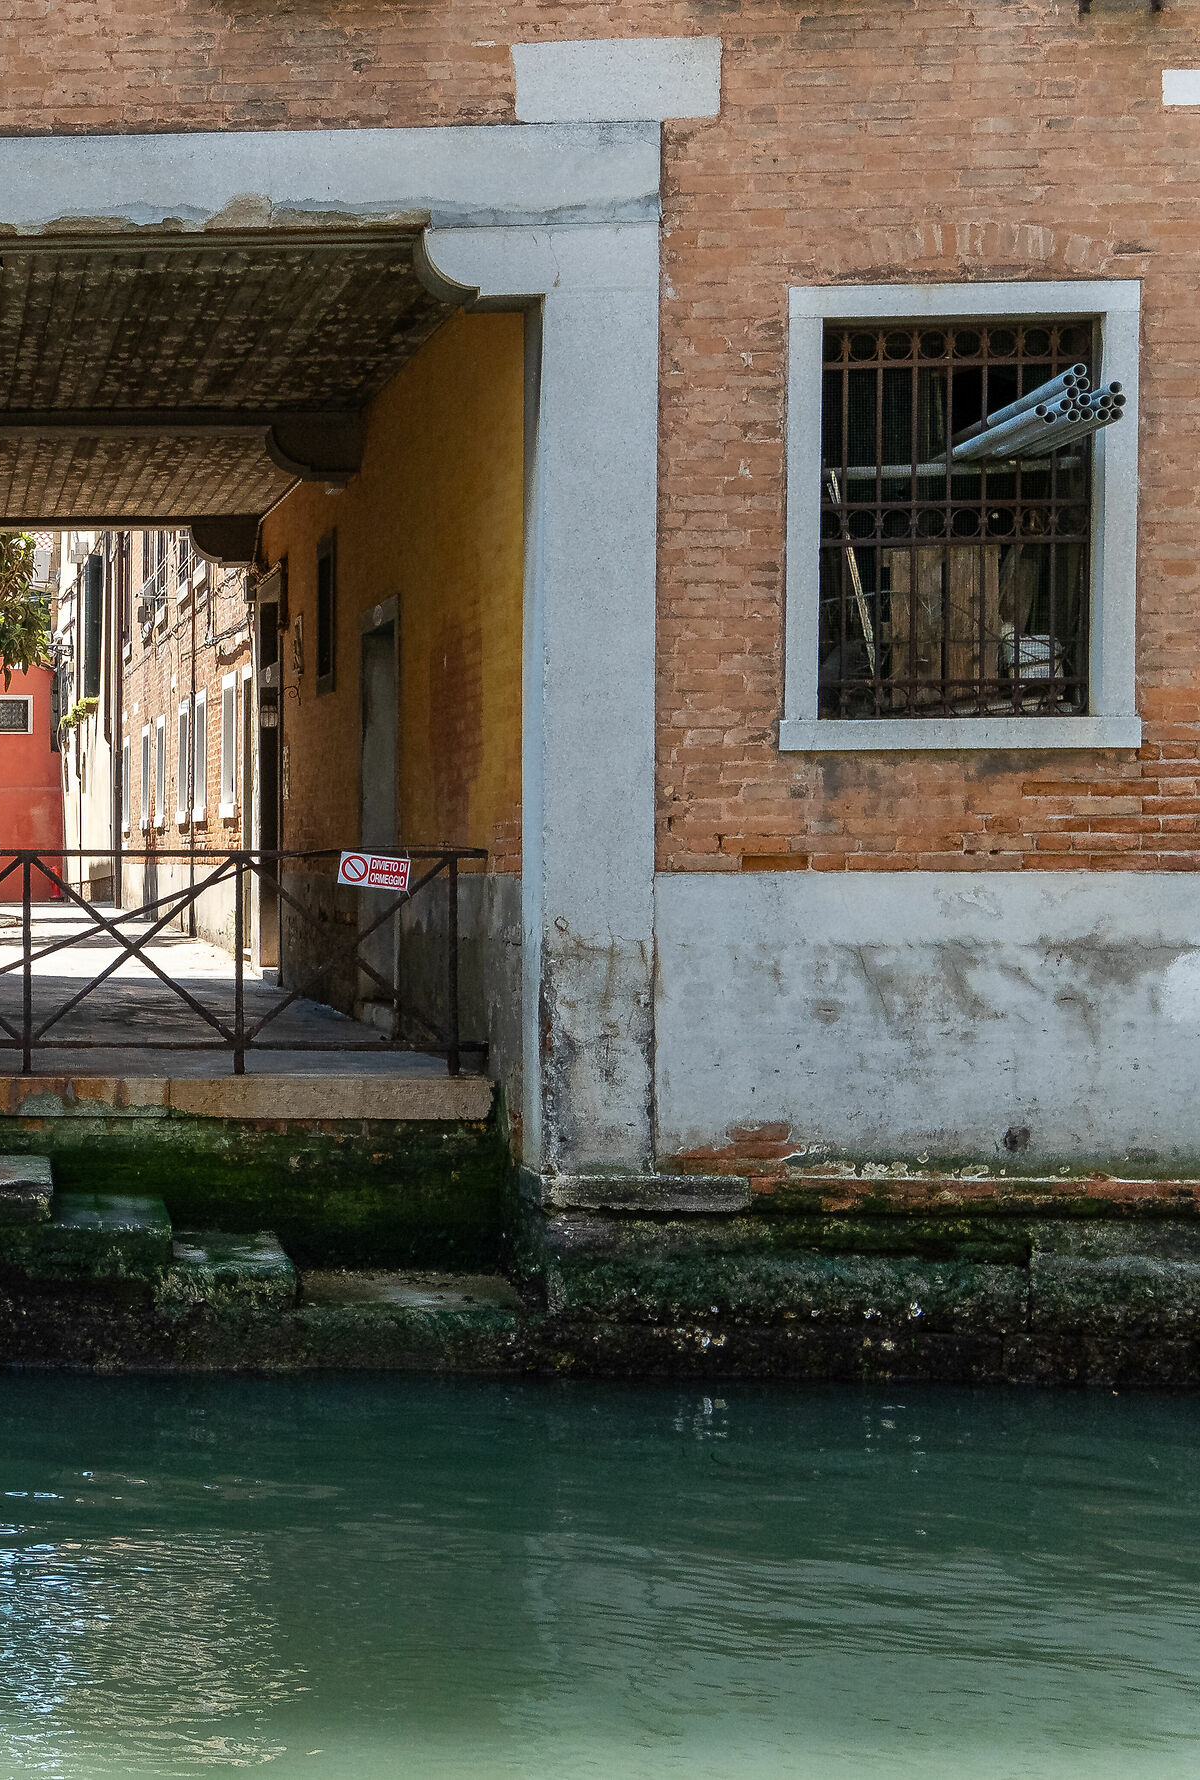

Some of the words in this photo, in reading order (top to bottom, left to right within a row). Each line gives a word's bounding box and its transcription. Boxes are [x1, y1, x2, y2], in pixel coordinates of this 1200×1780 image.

[371, 859, 399, 872] DIVIETO
[399, 862, 407, 873] DI
[369, 872, 405, 886] ORMEGGIO
